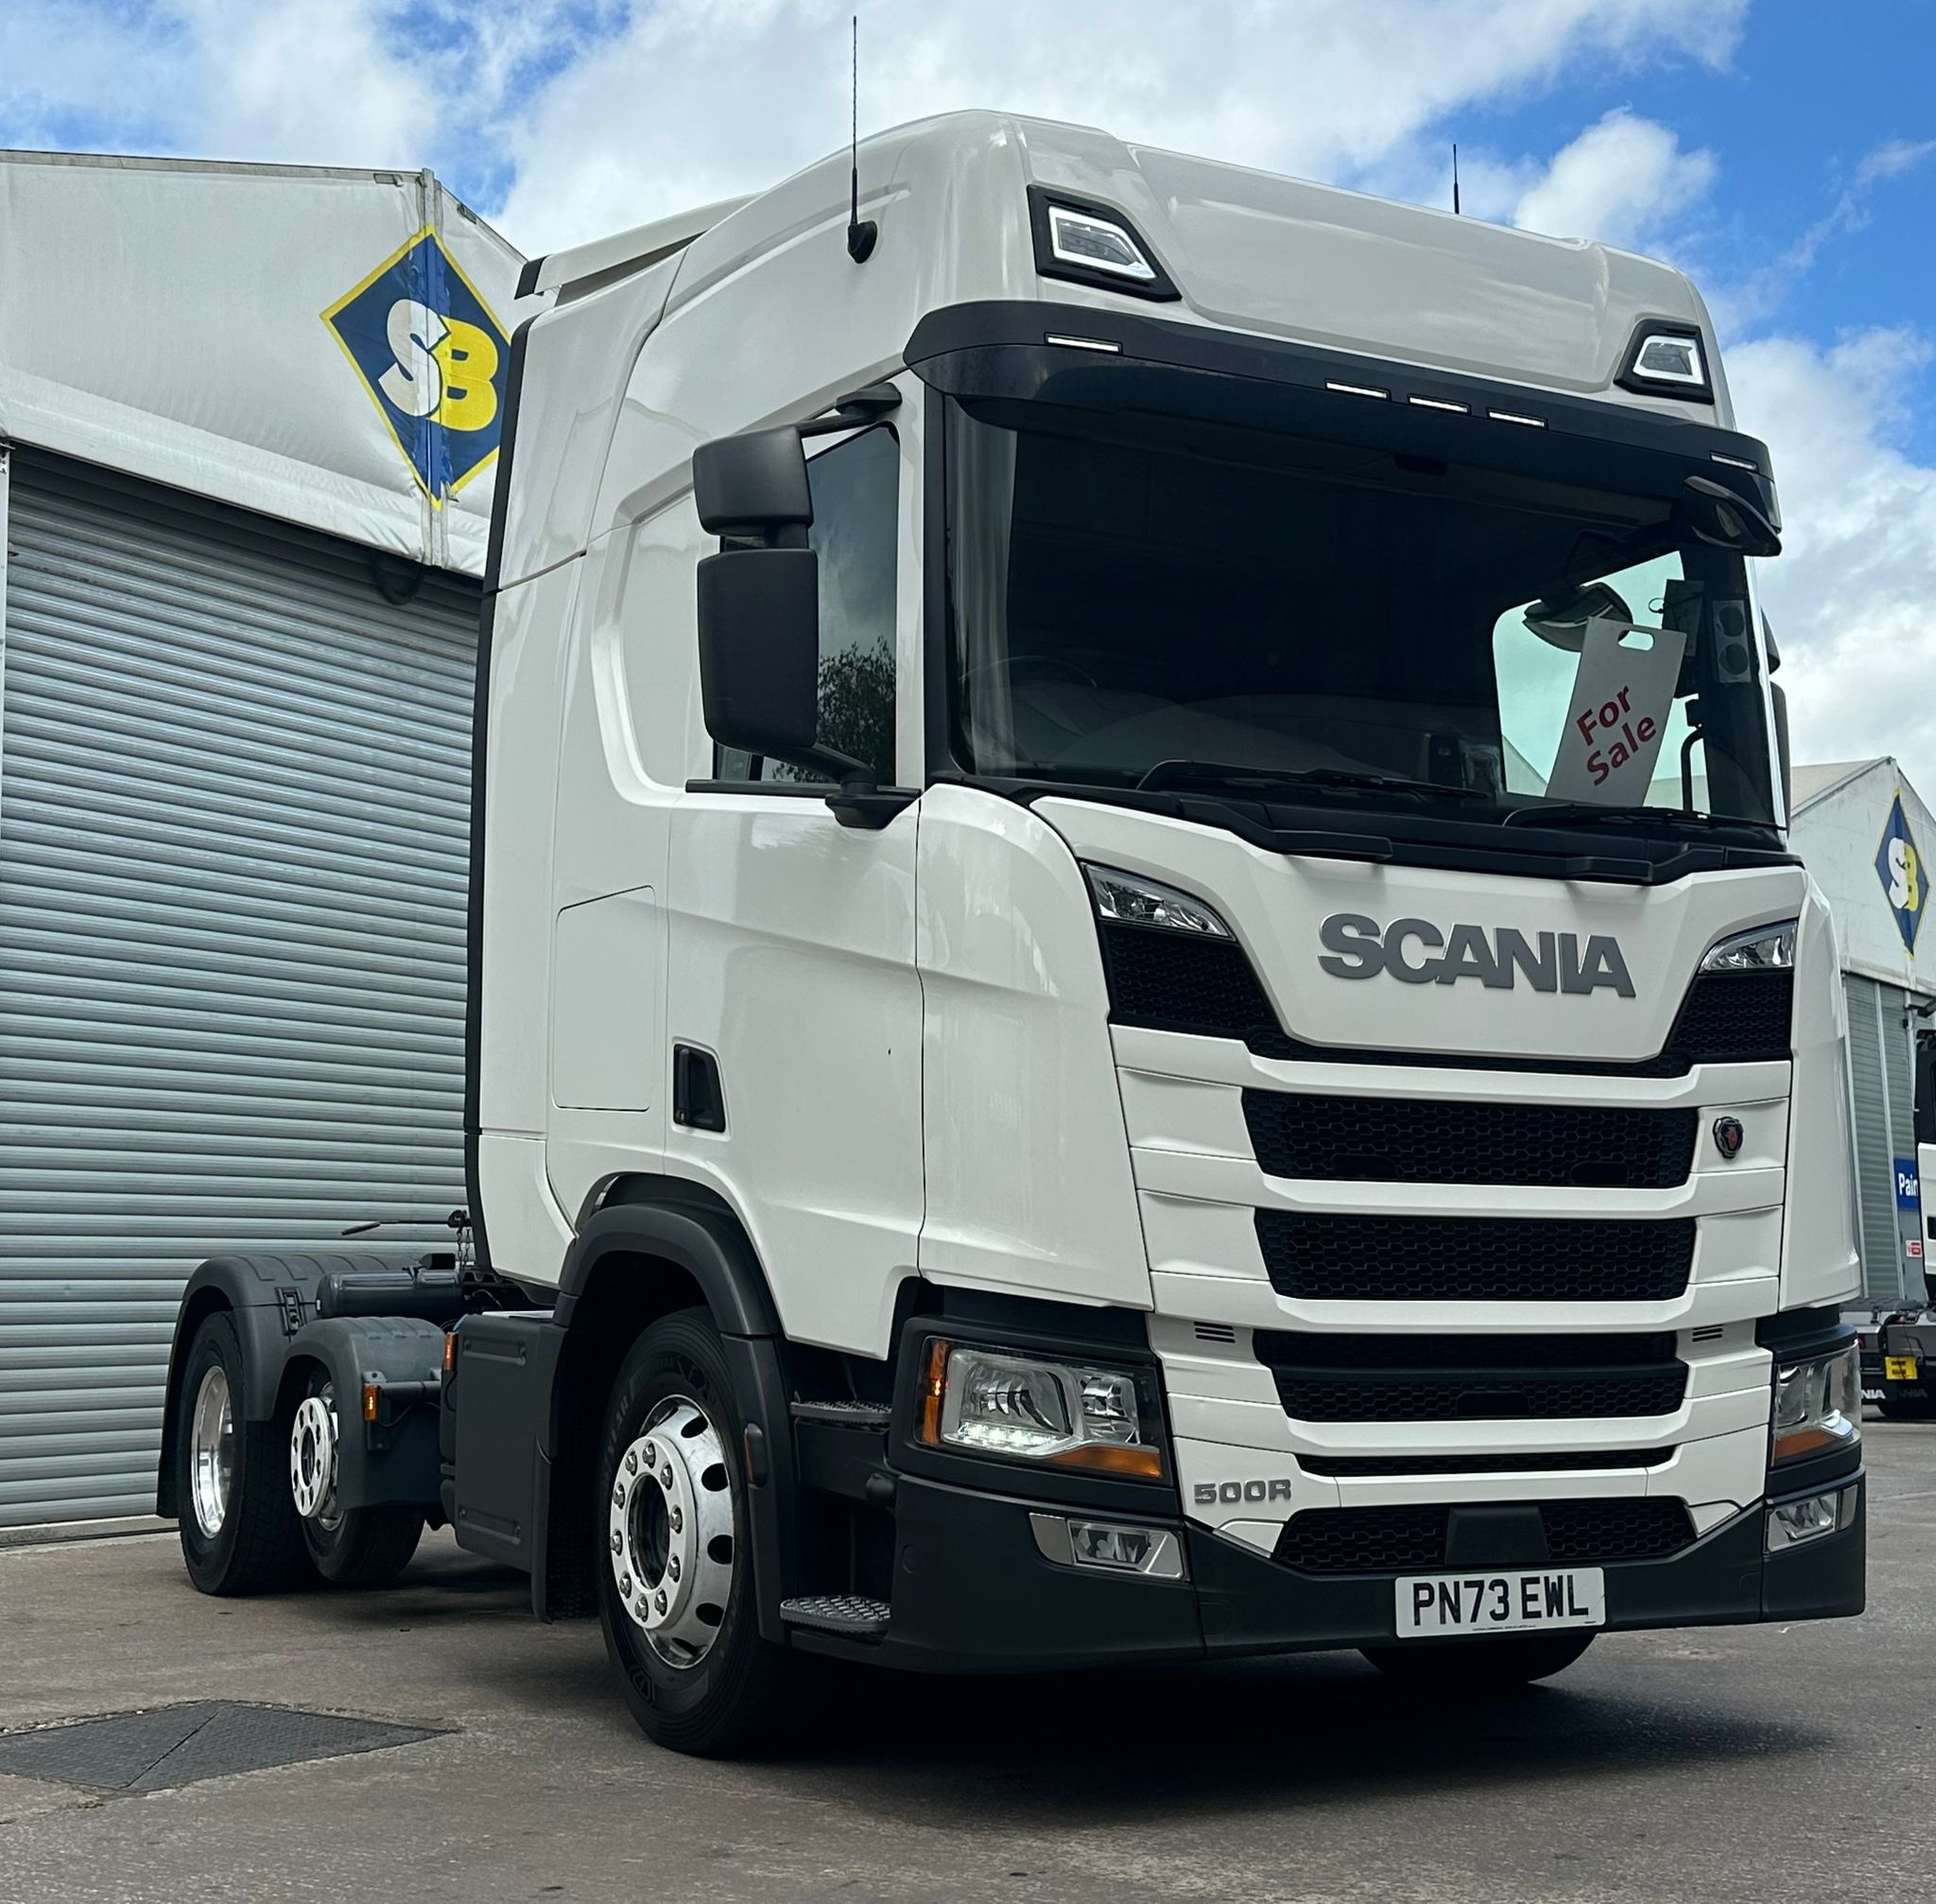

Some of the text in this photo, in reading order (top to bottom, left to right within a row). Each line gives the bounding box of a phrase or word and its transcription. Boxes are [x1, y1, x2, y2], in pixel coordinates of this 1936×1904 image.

[378, 299, 499, 431] SB
[1576, 685, 1632, 746] For
[1586, 716, 1657, 786] Sale
[1318, 912, 1636, 997] SCANIA
[1898, 1172, 1918, 1196] Pain
[1861, 1388, 1887, 1399] NIA
[1194, 1479, 1291, 1504] 500R
[1413, 1574, 1589, 1626] PN73 EWL
